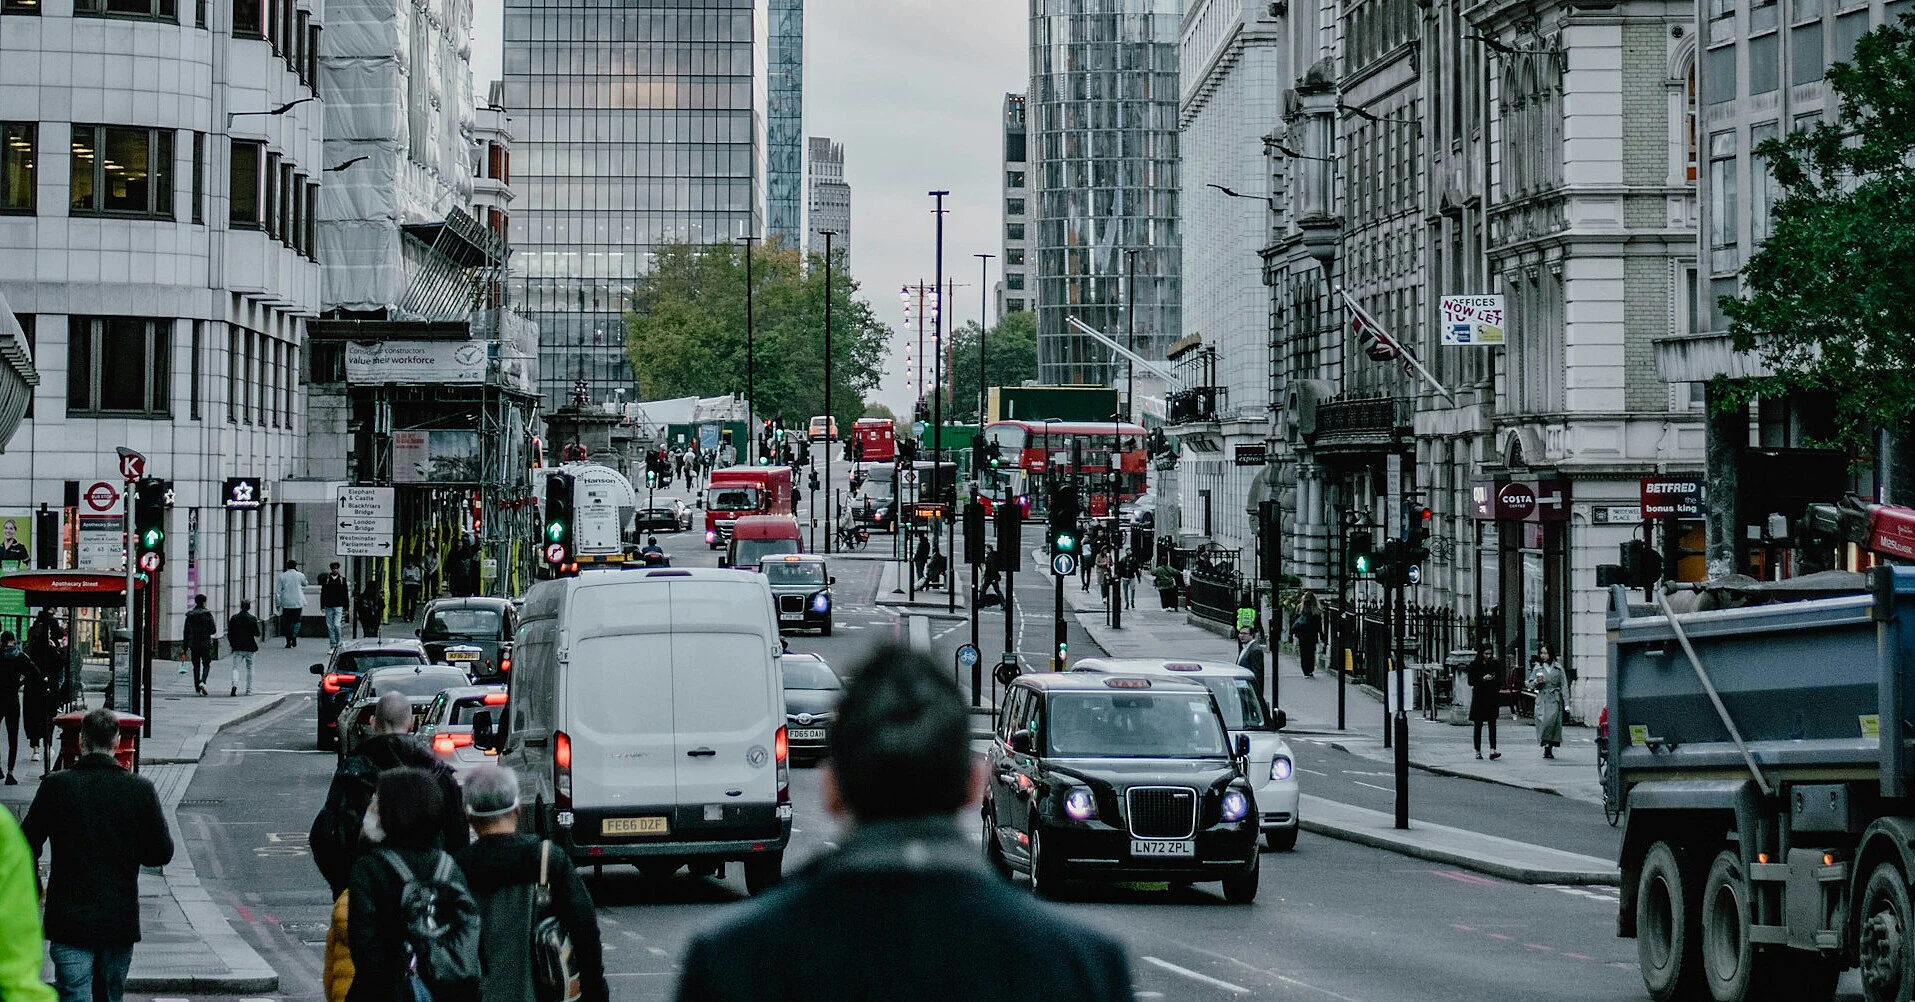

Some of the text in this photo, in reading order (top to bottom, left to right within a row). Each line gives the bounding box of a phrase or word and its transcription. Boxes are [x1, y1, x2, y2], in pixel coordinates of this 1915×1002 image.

[1443, 299, 1475, 316] NOW
[1477, 311, 1503, 326] LET
[384, 347, 426, 355] constructors
[348, 356, 372, 365] value
[391, 355, 435, 365] workforce
[124, 457, 140, 476] K
[1645, 483, 1697, 494] BETFRED
[1502, 495, 1533, 504] COSTA
[1645, 503, 1698, 513] bonus king
[51, 580, 82, 588] Apothecary
[607, 819, 662, 831] FE66 DZF
[1135, 842, 1190, 853] LN72 ZPL
